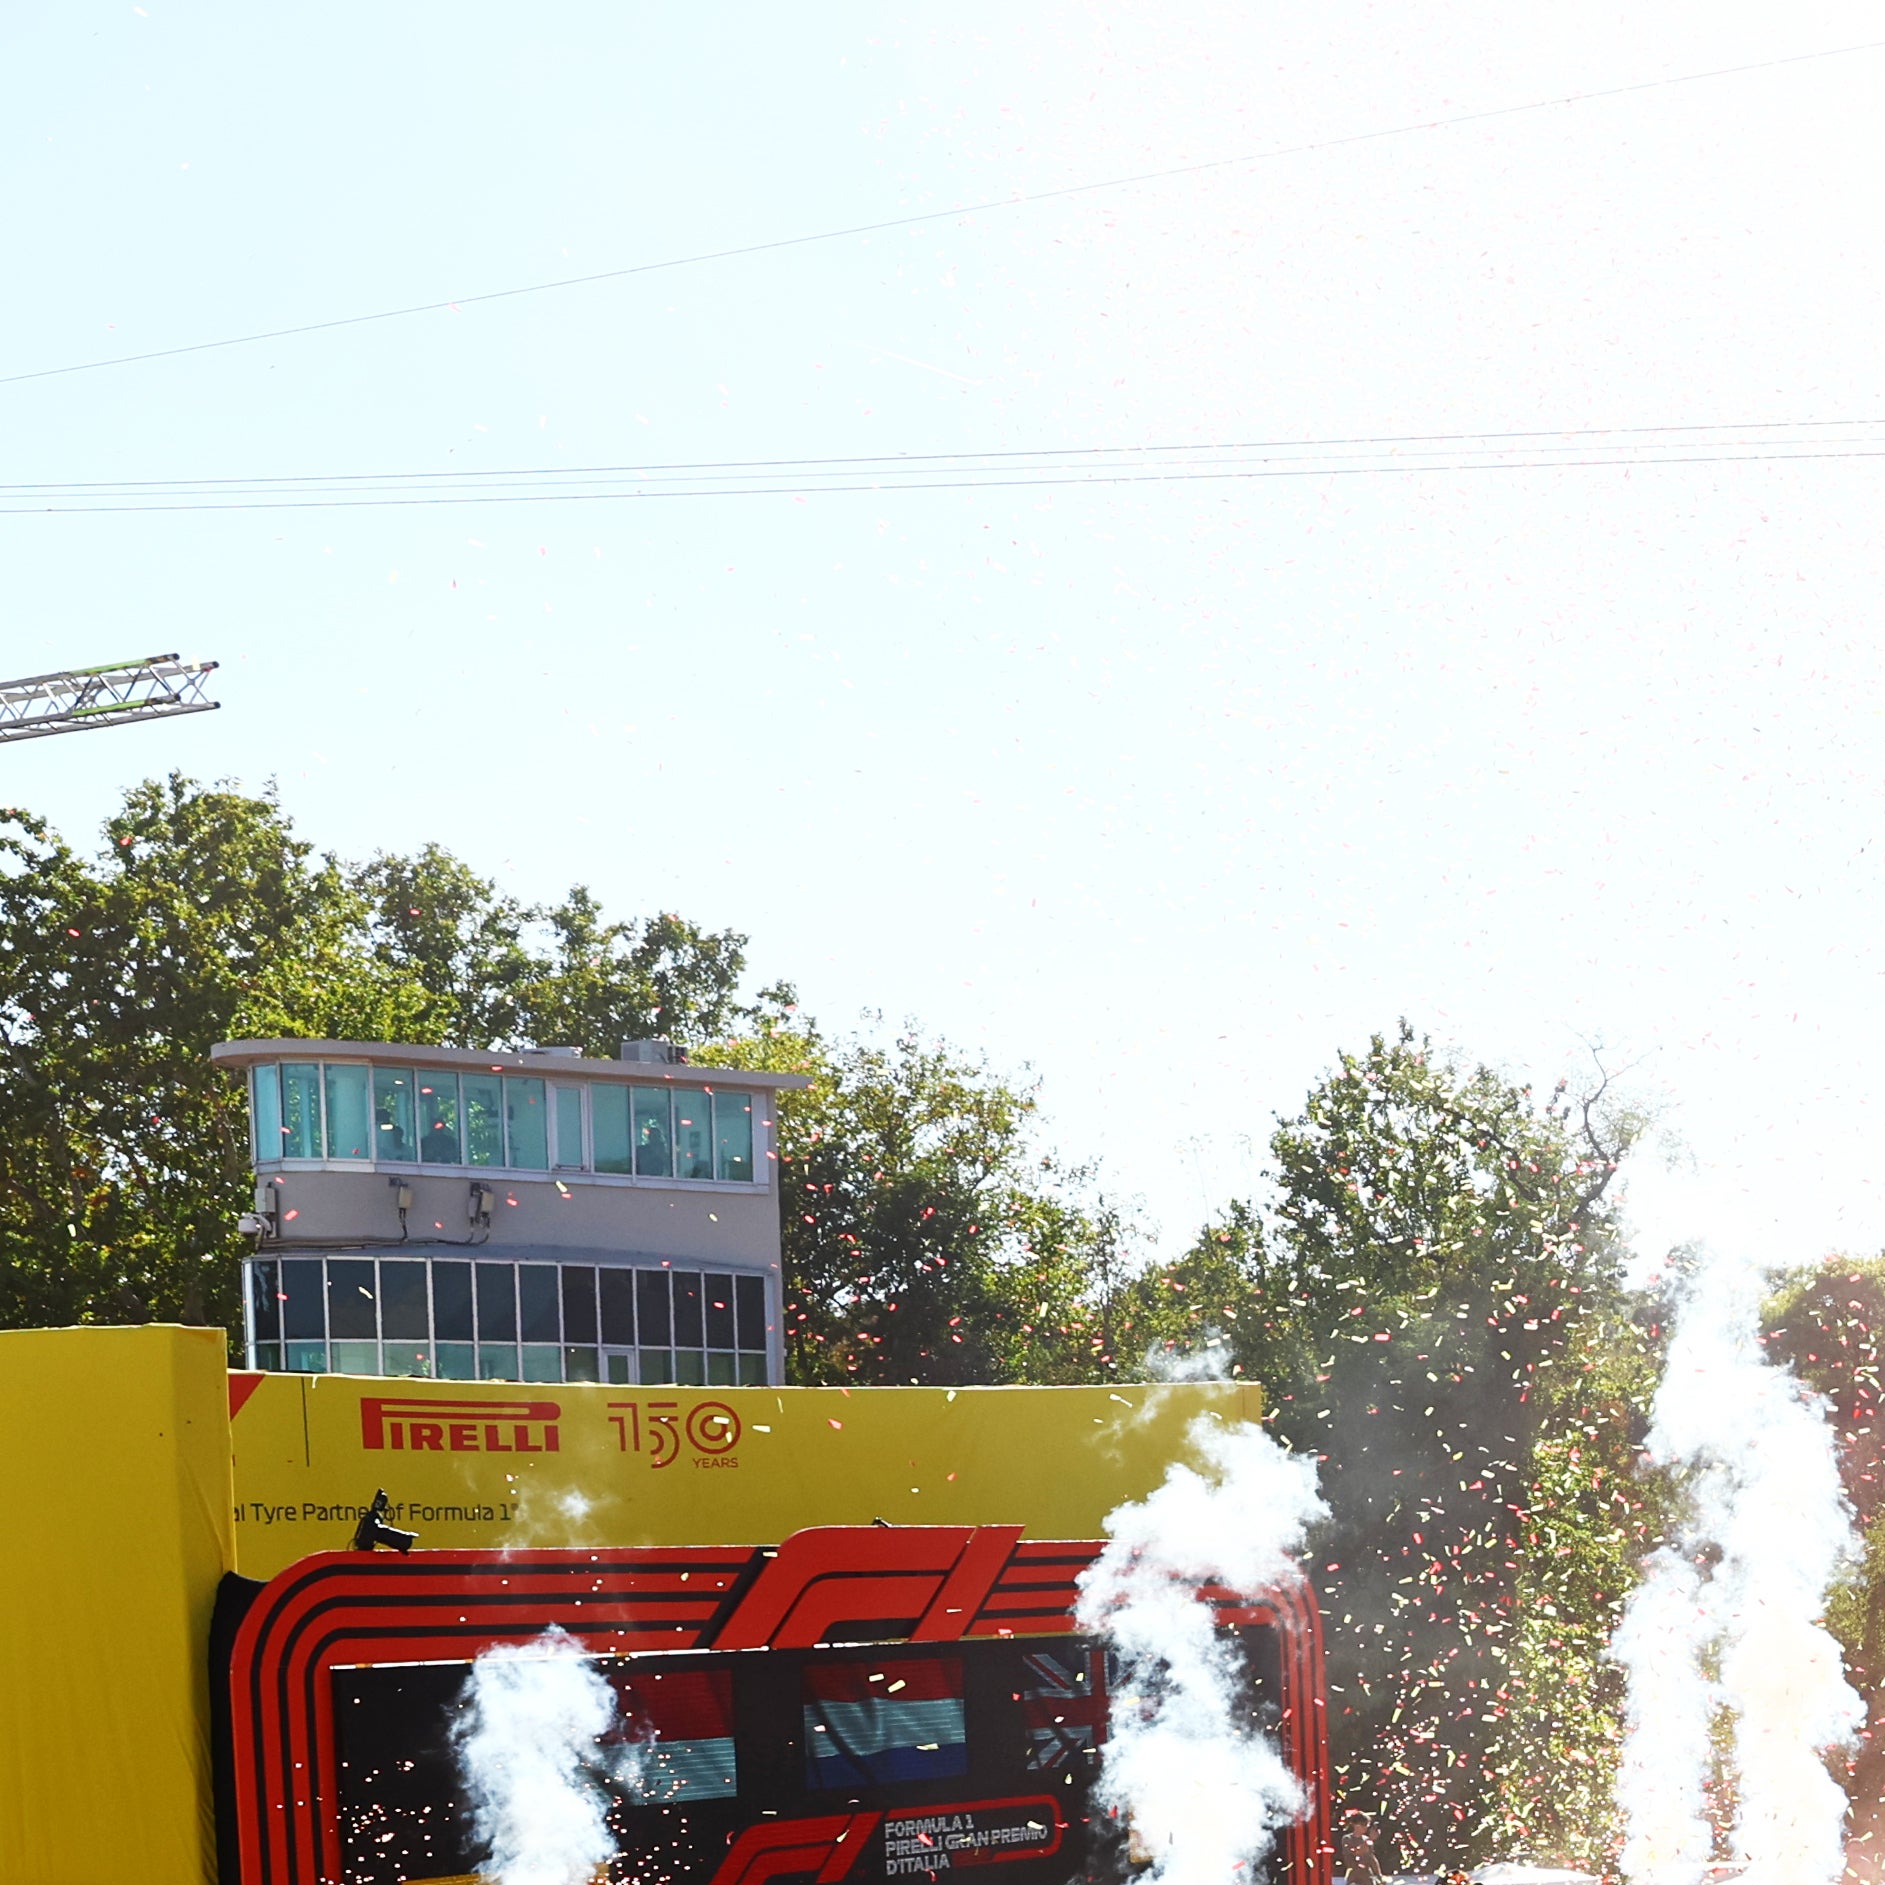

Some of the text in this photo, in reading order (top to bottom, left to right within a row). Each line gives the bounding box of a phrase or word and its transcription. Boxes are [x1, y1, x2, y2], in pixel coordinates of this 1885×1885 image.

[361, 1397, 741, 1469] PIRELLI 150
[692, 1457, 739, 1469] YEARS
[250, 1503, 297, 1525] Tyre
[302, 1503, 368, 1522] Partne
[409, 1502, 493, 1521] Formula
[885, 1814, 974, 1838] FORMULA 1
[886, 1824, 1048, 1858] PIRELLI GRAN PREMIO
[886, 1854, 951, 1876] D'ITALIA
